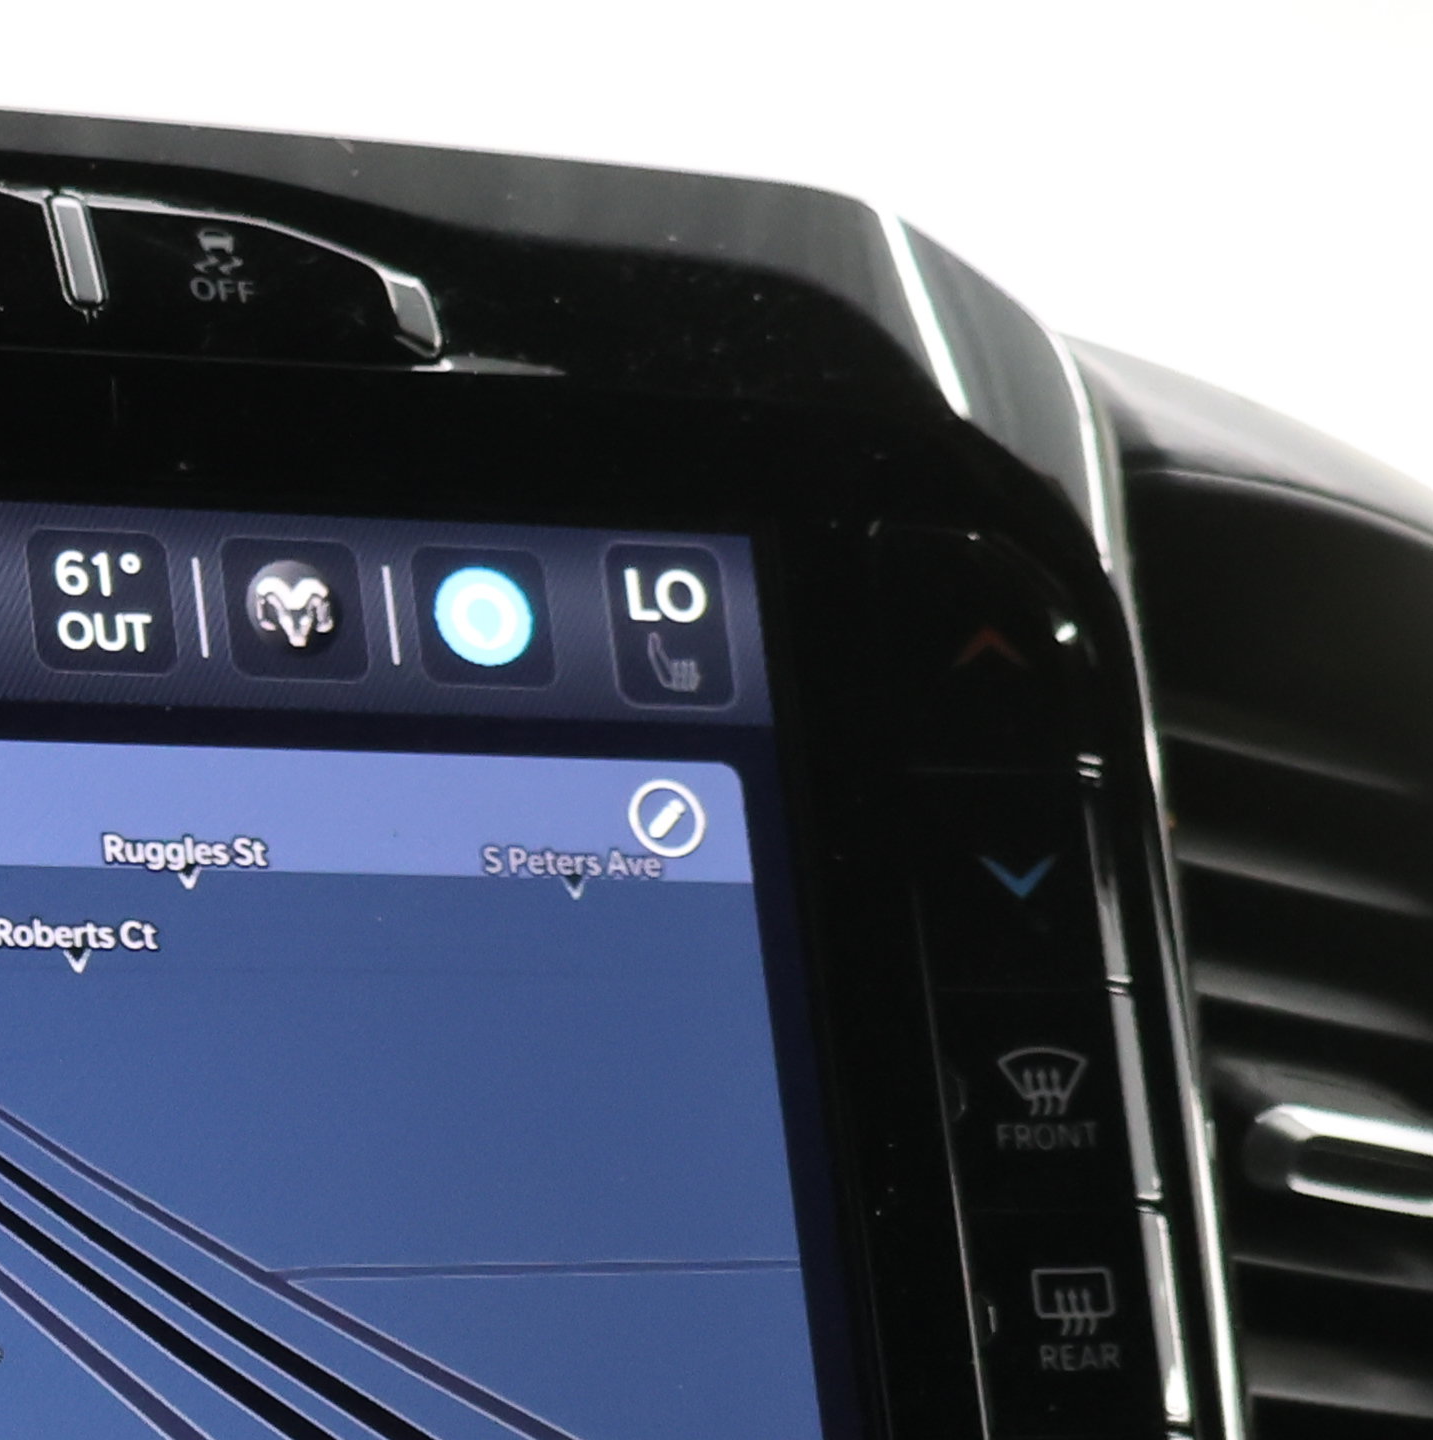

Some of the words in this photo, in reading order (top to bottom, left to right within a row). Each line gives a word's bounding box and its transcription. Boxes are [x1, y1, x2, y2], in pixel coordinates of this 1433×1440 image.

[191, 278, 252, 302] OFF
[55, 551, 140, 596] 61°
[625, 568, 706, 622] LO
[58, 611, 151, 651] OUT
[103, 834, 224, 872] Ruggles
[229, 839, 269, 868] St
[482, 845, 503, 874] S
[508, 848, 601, 875] Peters
[605, 848, 662, 880] Ave
[120, 921, 156, 949] Ct
[995, 1120, 1098, 1152] FRONT
[1040, 1344, 1119, 1371] REAR
